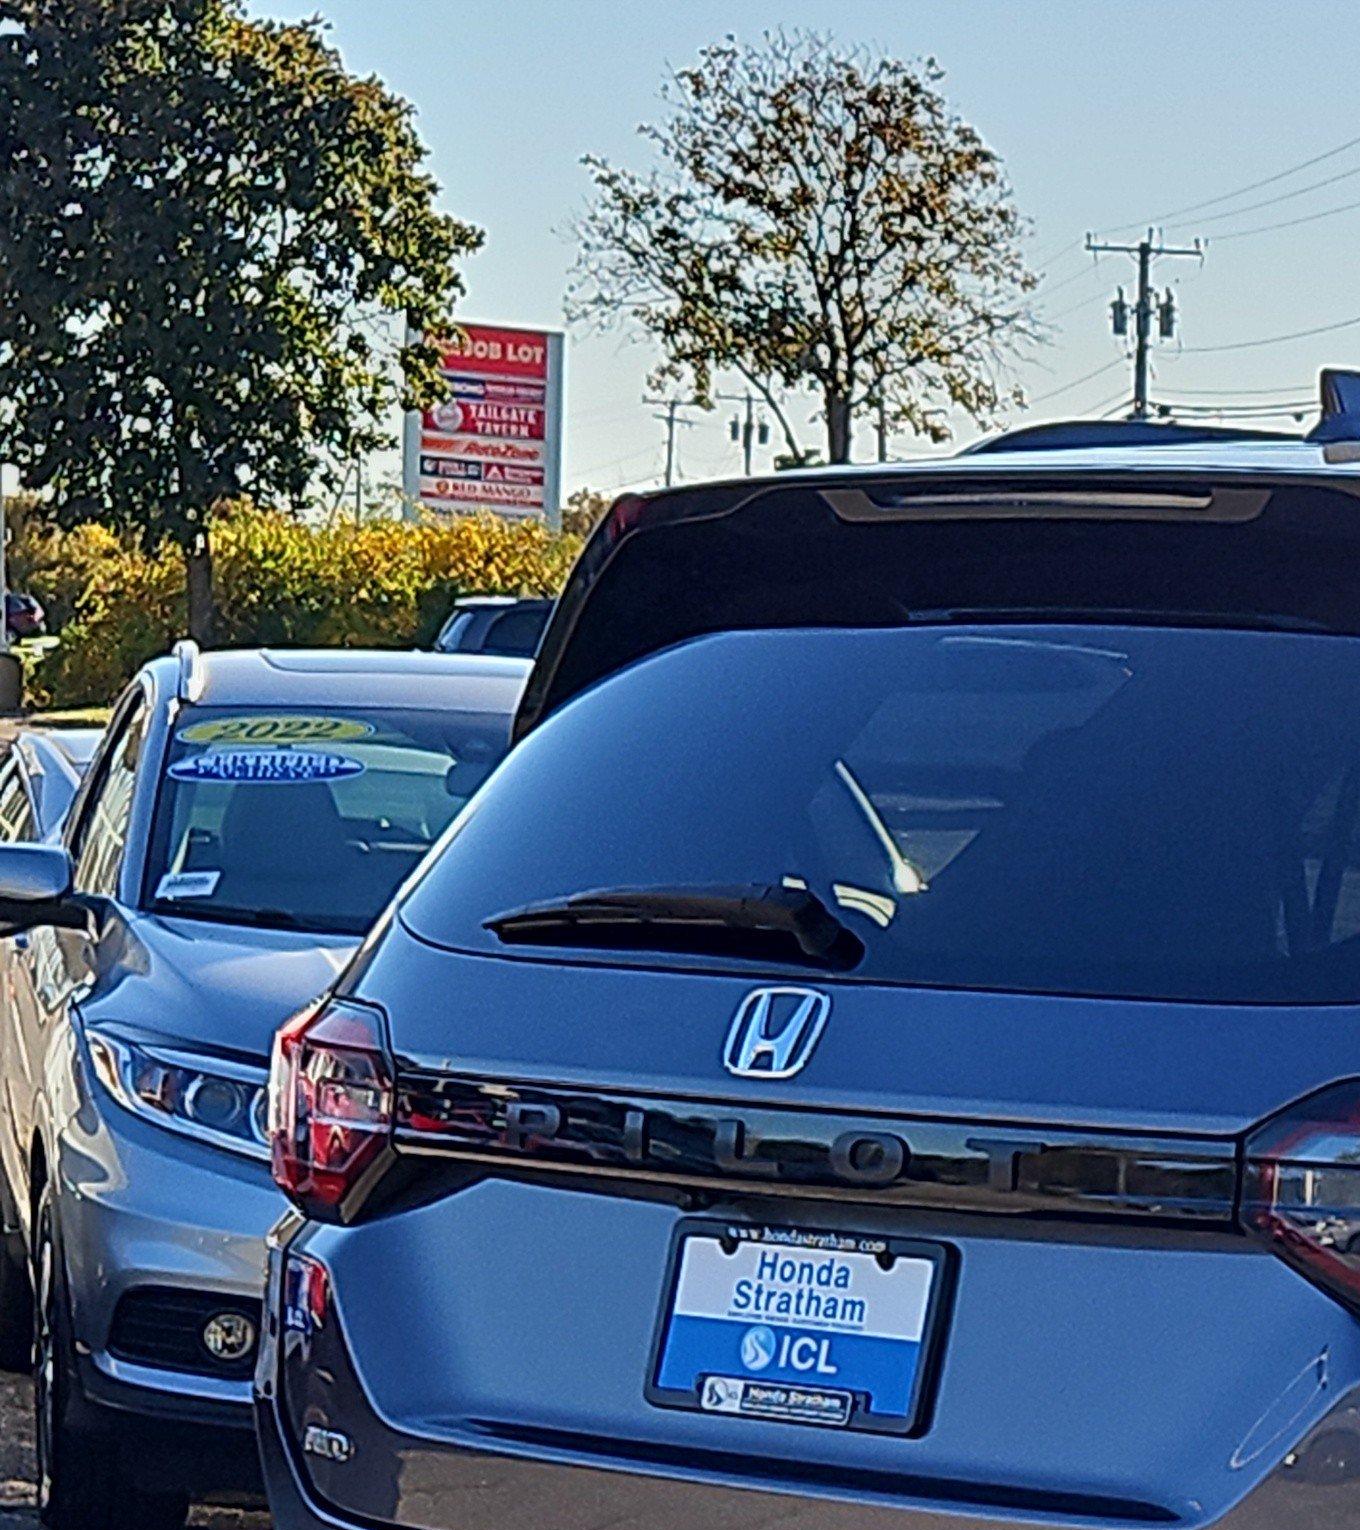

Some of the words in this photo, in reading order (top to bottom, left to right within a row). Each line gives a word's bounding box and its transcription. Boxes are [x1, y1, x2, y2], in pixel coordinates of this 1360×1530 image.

[506, 342, 544, 364] LOT
[469, 403, 537, 425] TAILGATE
[475, 420, 530, 437] TAVERN
[210, 721, 343, 741] 2022
[504, 1102, 1045, 1191] PILOT
[757, 1250, 851, 1289] Honda
[733, 1279, 866, 1323] Stratham
[778, 1335, 838, 1374] ICL
